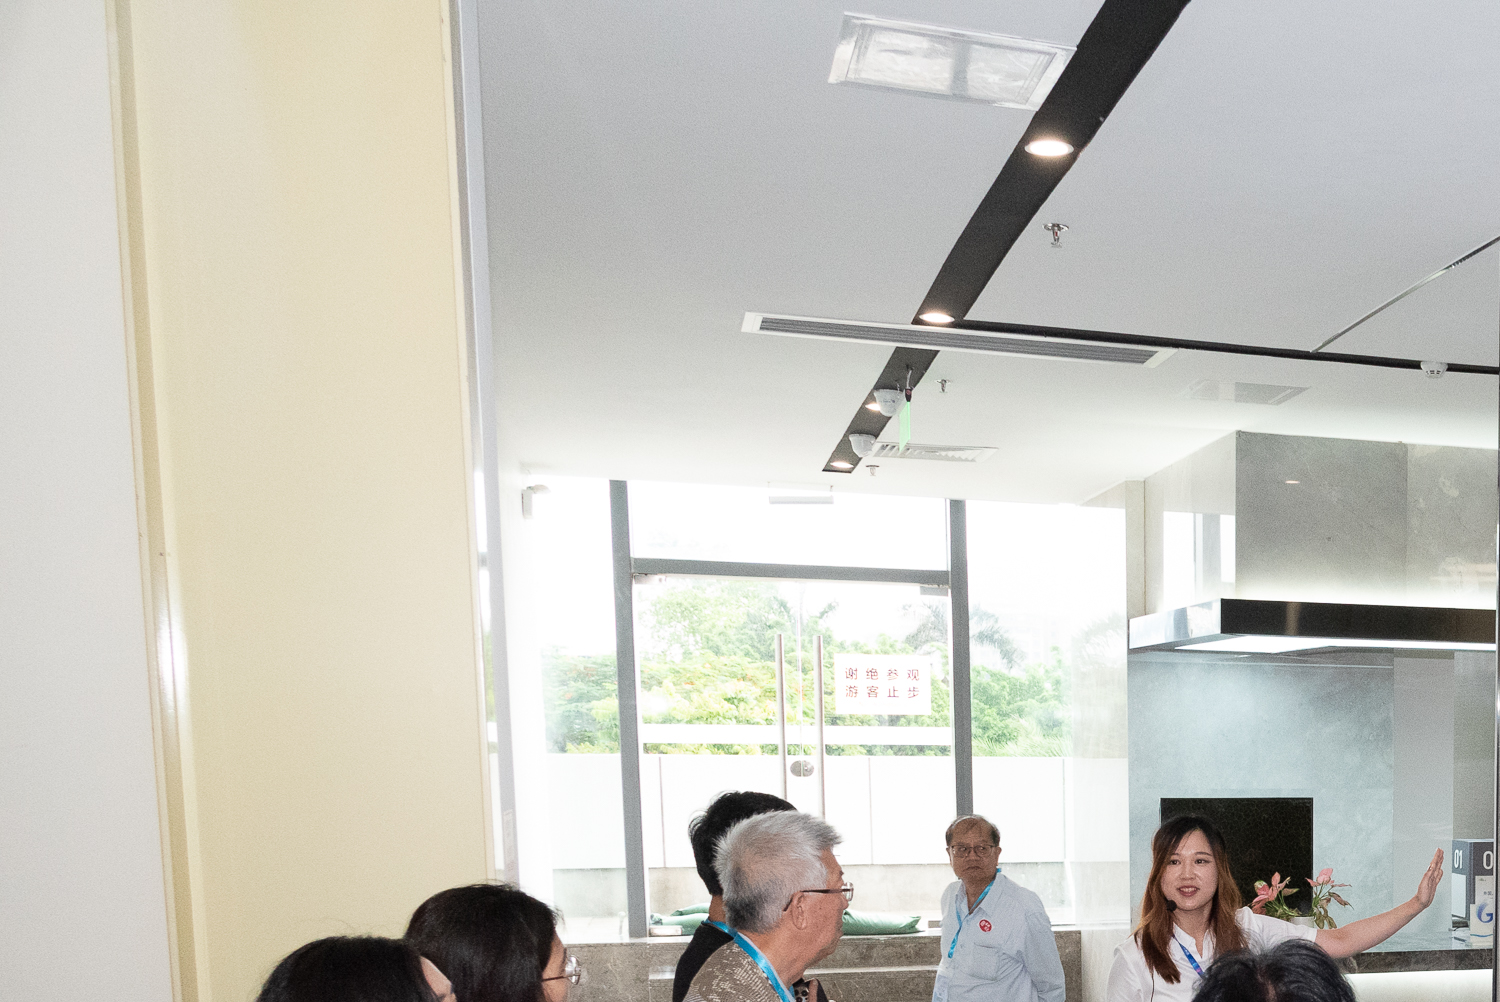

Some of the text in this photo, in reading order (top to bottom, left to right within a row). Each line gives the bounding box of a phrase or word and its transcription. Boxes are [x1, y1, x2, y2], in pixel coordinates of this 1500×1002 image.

[845, 667, 920, 682] 谢绝参观
[845, 685, 920, 699] 游客止步
[1454, 849, 1463, 869] 01
